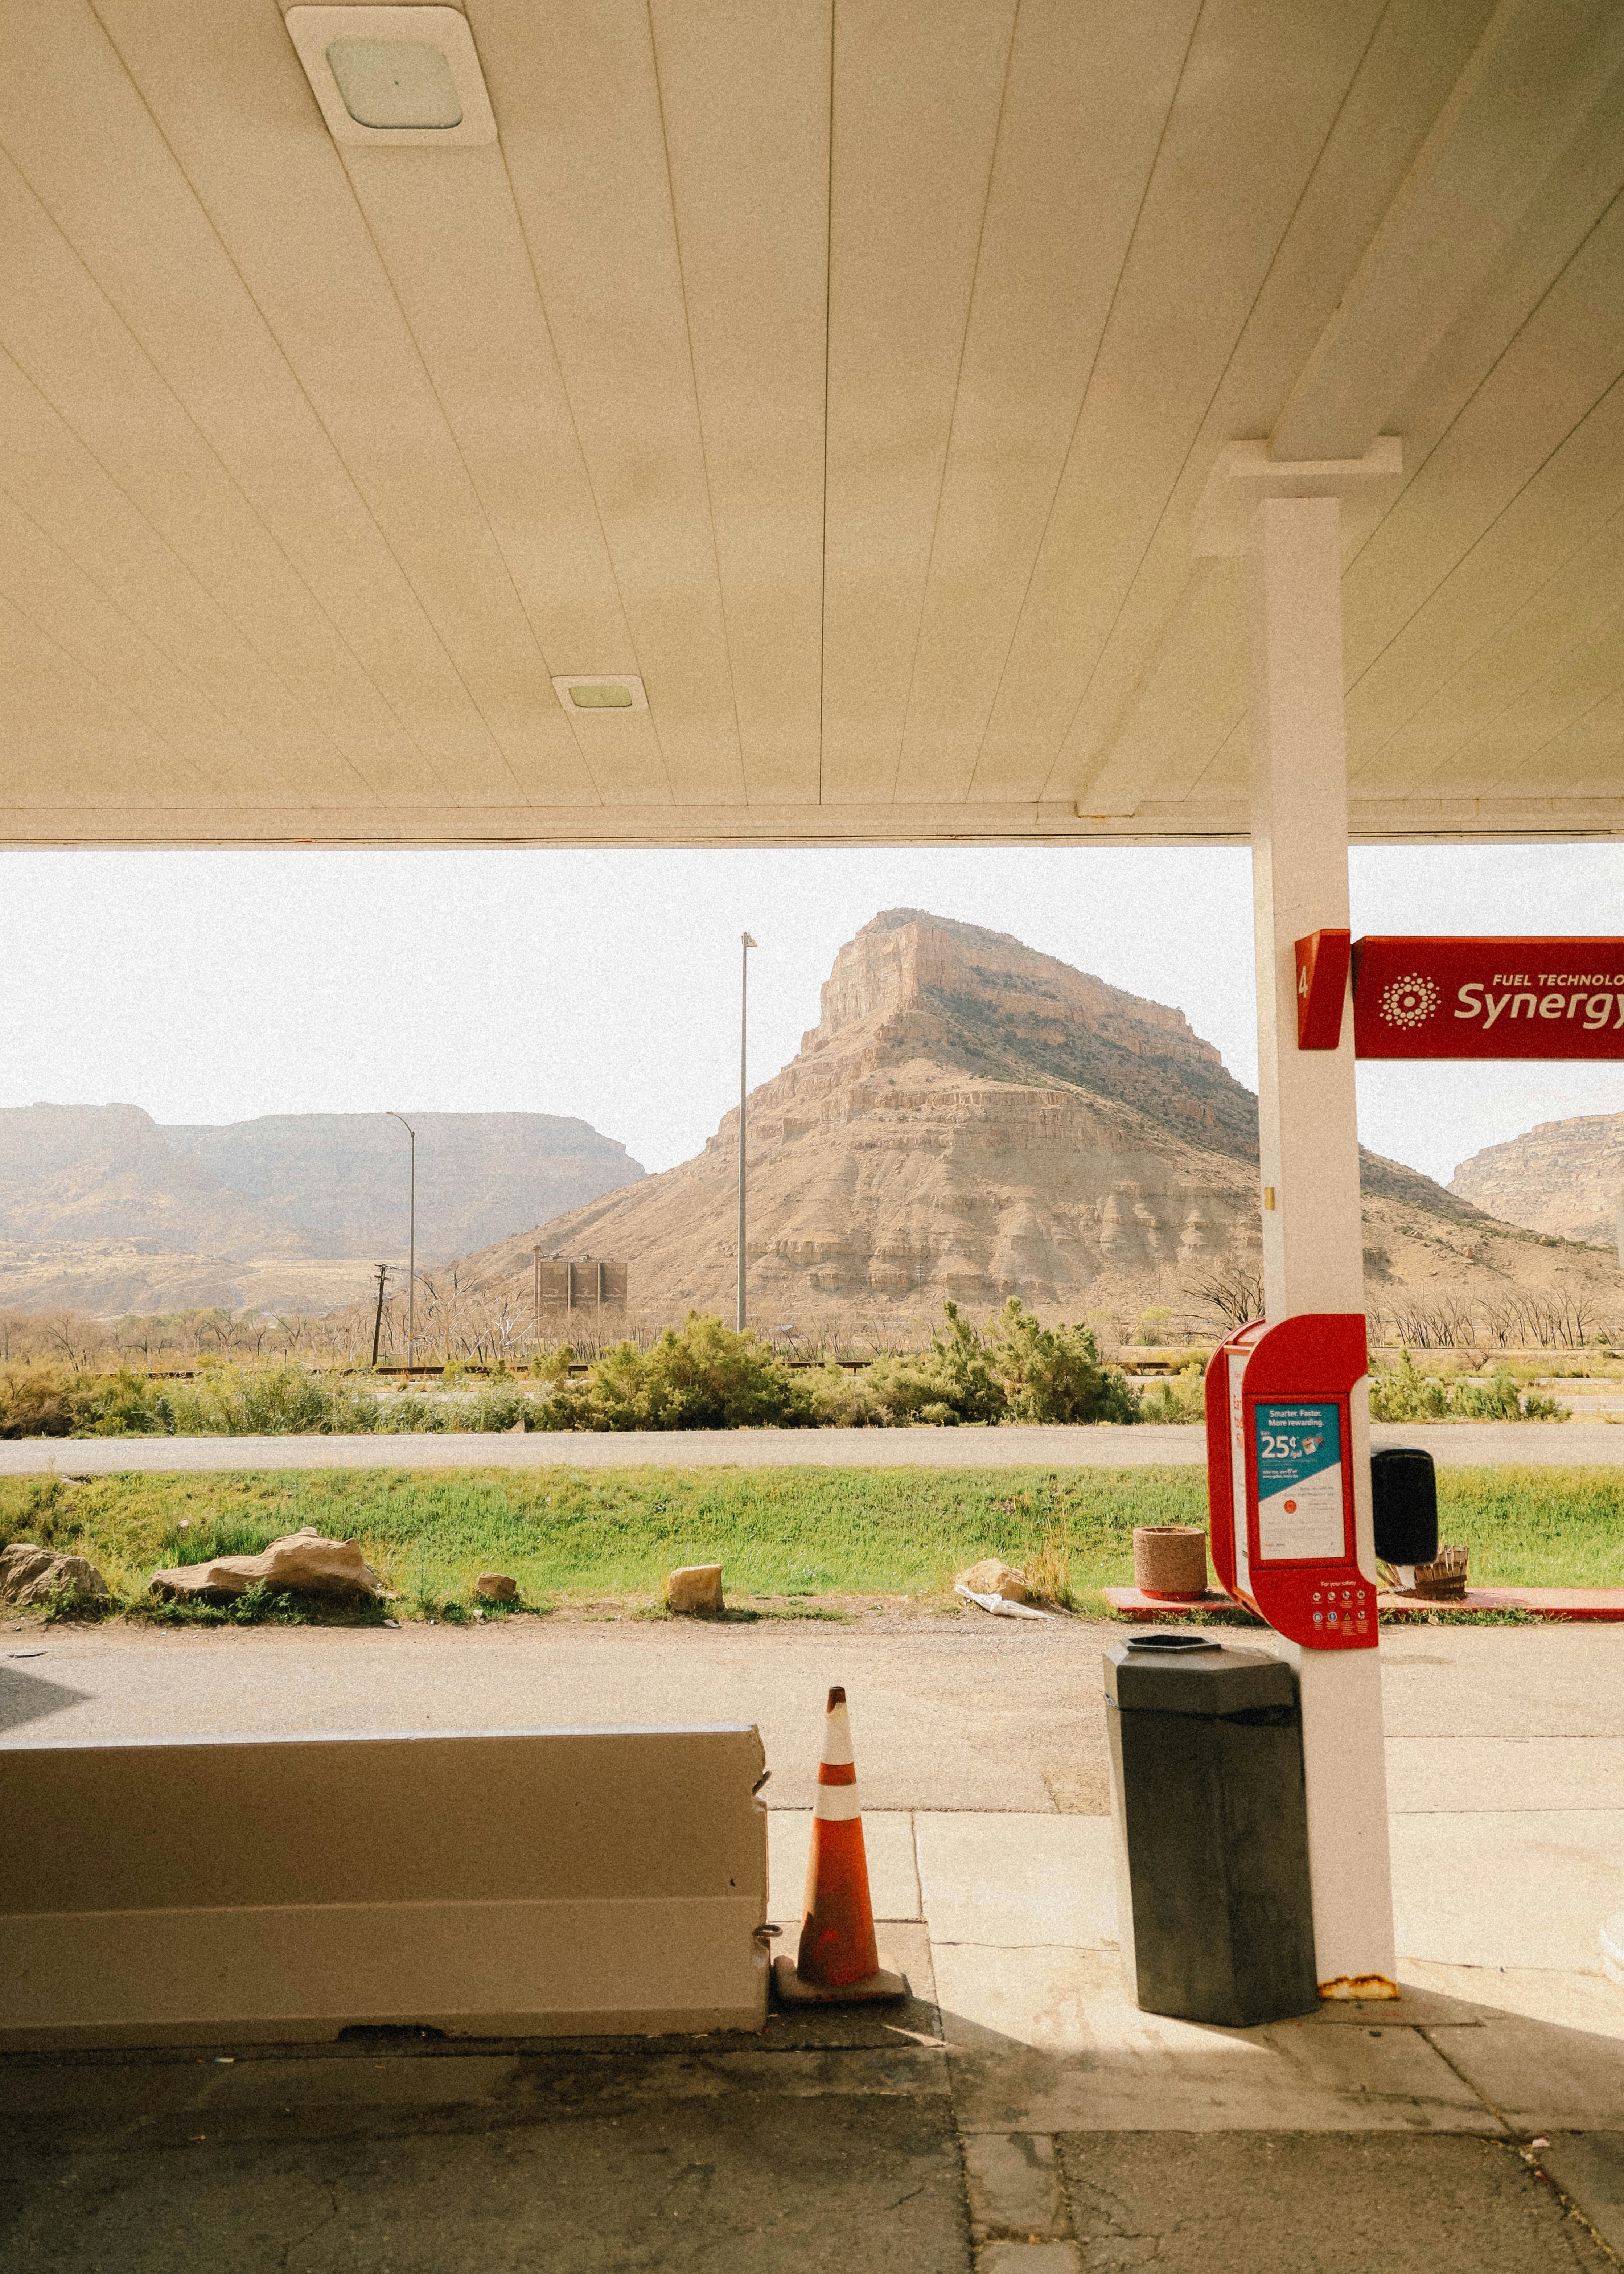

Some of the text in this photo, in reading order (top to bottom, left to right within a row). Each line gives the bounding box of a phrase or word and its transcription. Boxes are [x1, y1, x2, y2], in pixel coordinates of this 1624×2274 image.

[1298, 965, 1308, 998] 4
[1493, 974, 1532, 986] FUEL
[1288, 1418, 1324, 1428] rewarding.
